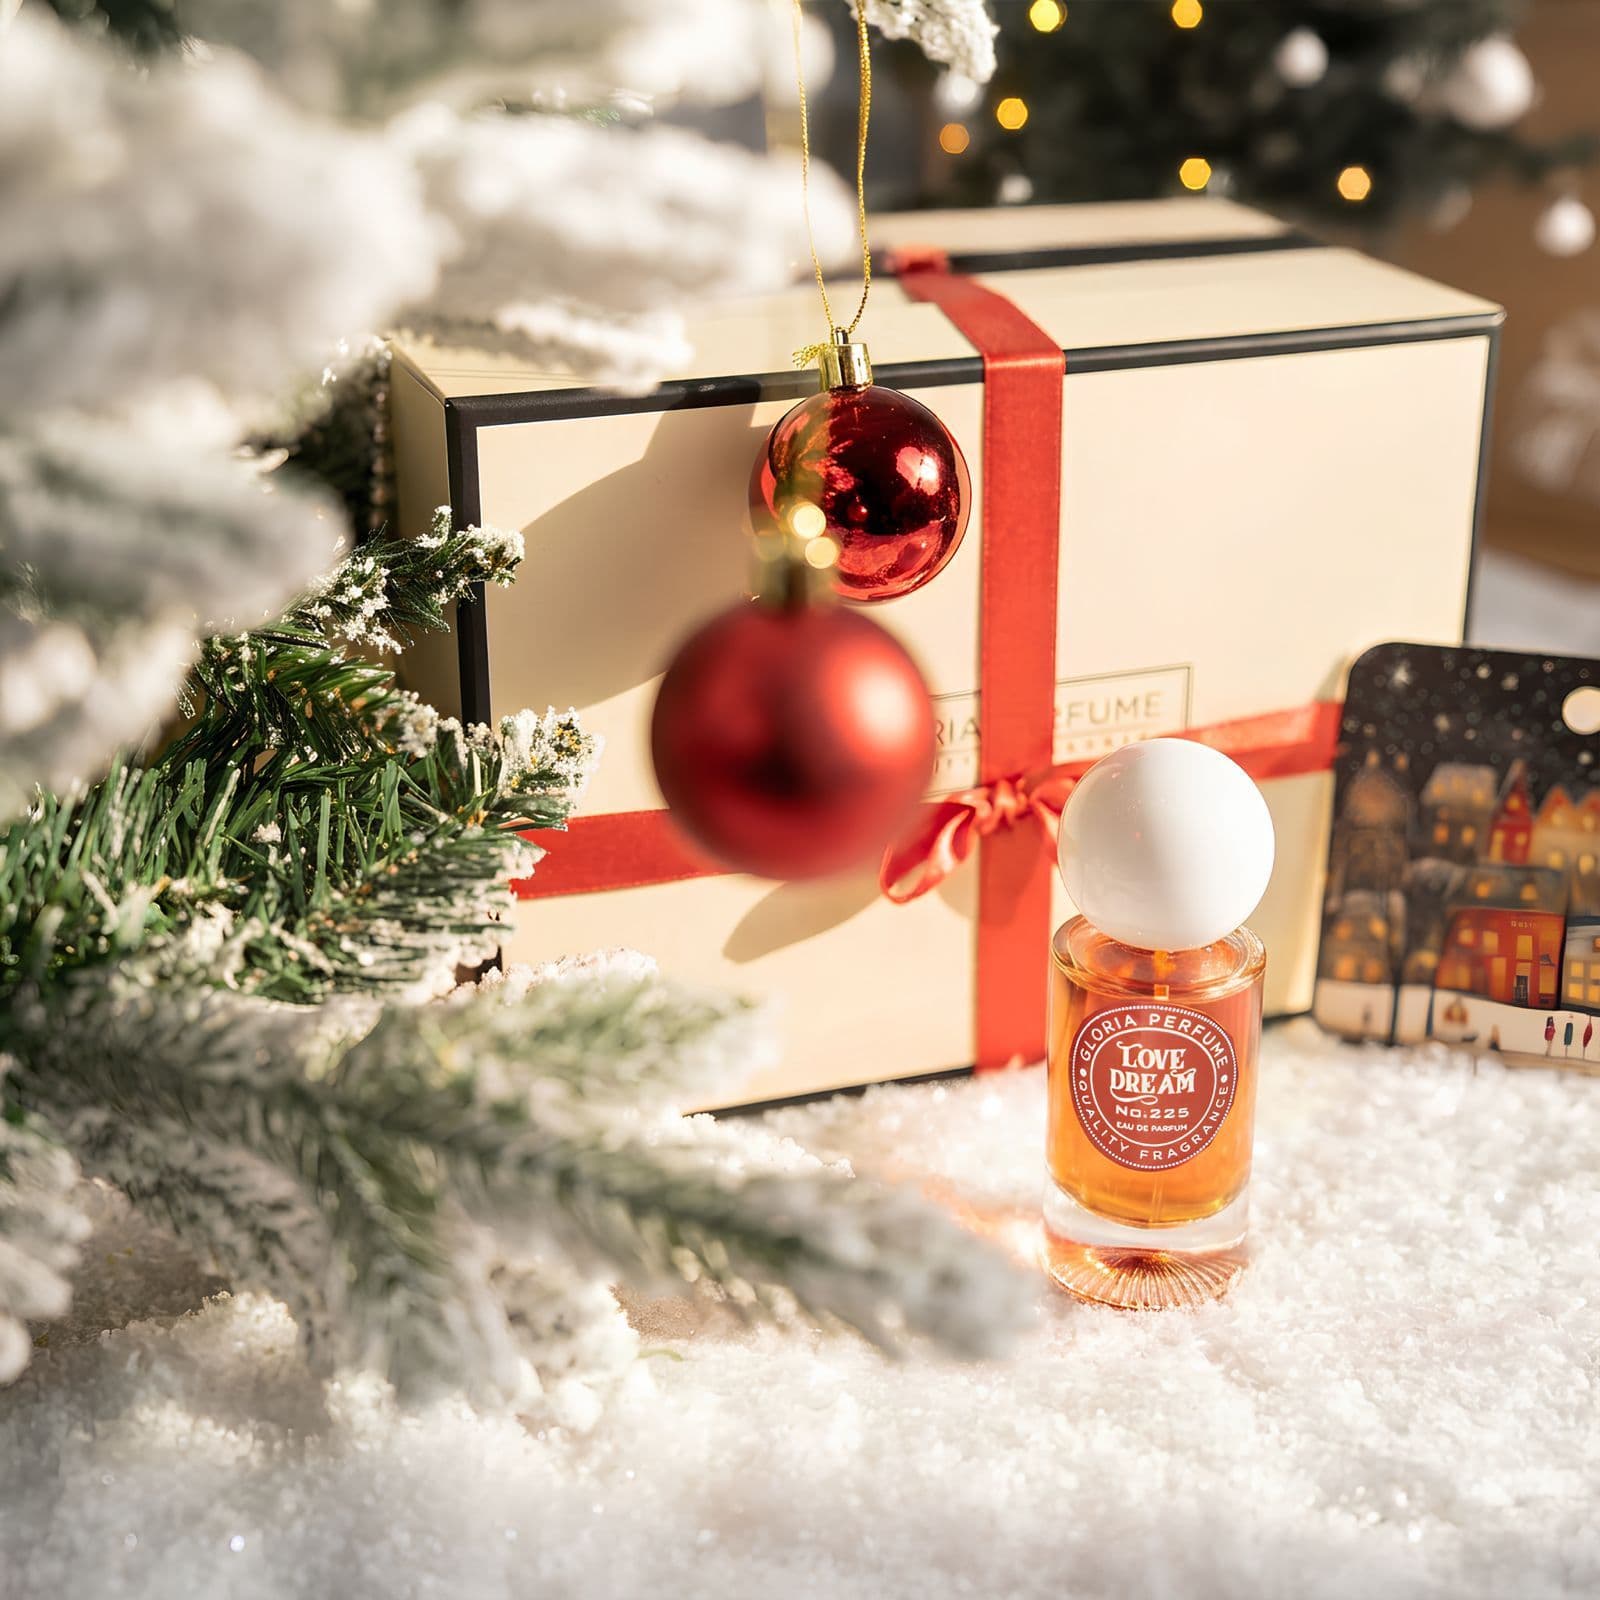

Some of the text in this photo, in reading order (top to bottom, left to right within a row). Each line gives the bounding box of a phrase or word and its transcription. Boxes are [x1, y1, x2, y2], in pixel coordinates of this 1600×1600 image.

[935, 690, 1165, 745] RIA FUME
[1080, 1013, 1228, 1069] GLORIA PERFUME
[1116, 1041, 1187, 1069] LOVE
[1109, 1067, 1197, 1105] DREAM
[1079, 1080, 1229, 1161] QUALITY FRAGRANCE
[1116, 1121, 1188, 1132] EAU DE PARFUM
